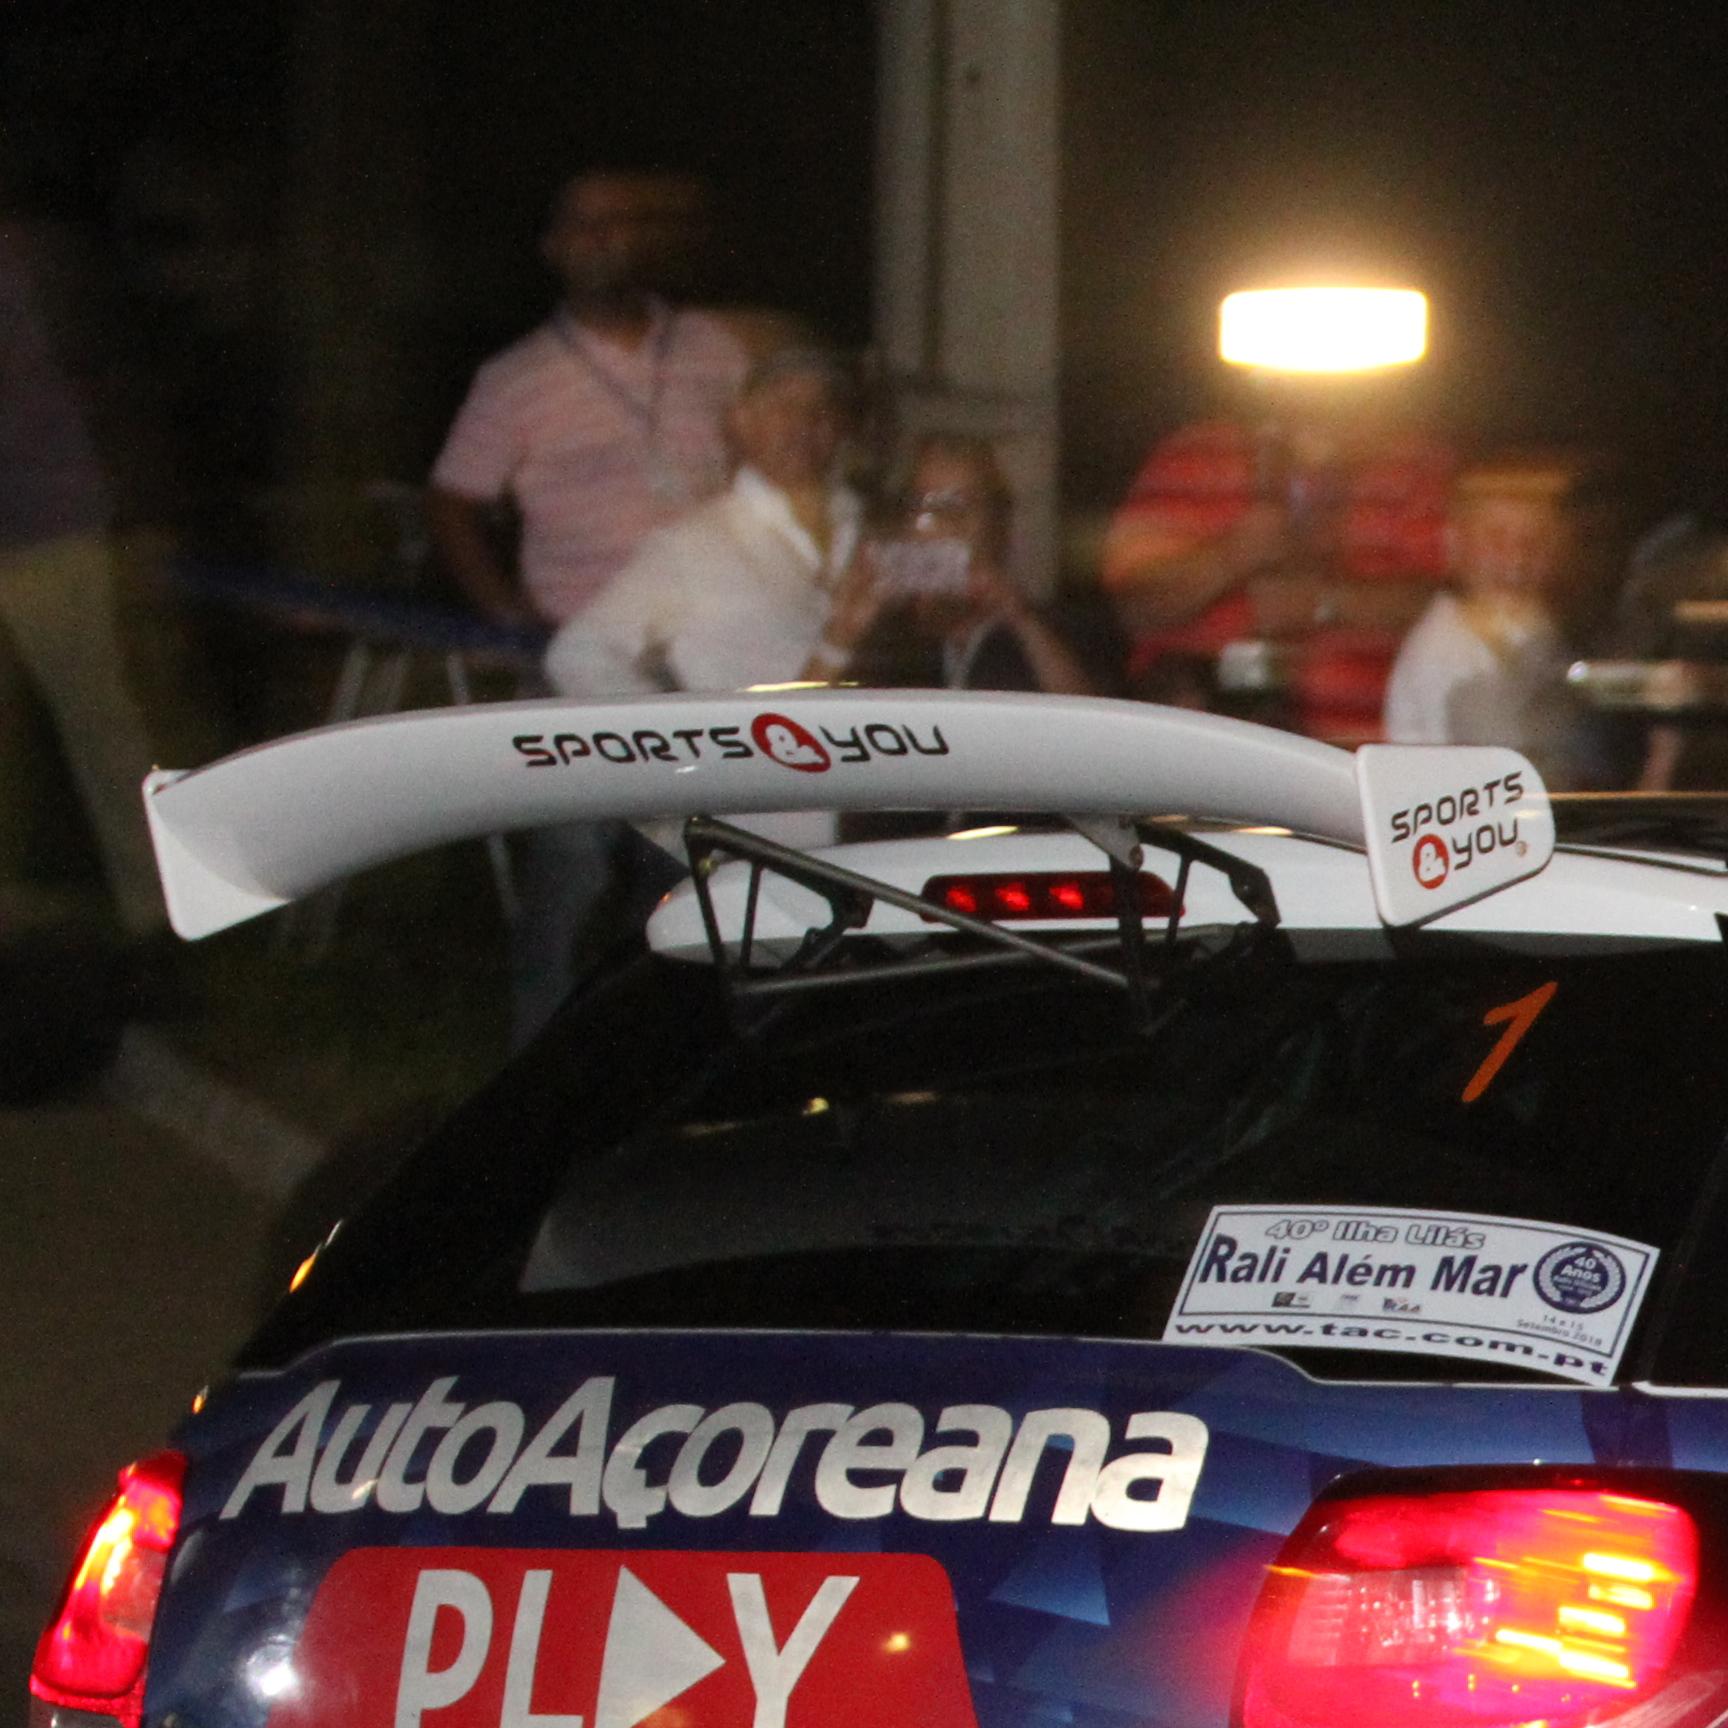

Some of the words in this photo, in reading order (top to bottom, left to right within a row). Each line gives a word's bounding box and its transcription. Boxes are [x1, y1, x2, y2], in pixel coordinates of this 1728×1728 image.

[1391, 770, 1525, 843] SPORTS
[1461, 981, 1558, 1103] 1
[1198, 1232, 1291, 1284] Rali
[1296, 1252, 1416, 1288] Além
[1430, 1254, 1528, 1299] Mar
[1332, 1220, 1398, 1243] Ilha
[1404, 1223, 1487, 1249] Lilás
[1560, 1264, 1601, 1284] Anos
[1176, 1322, 1609, 1377] www.tac.com.pt
[220, 1376, 1209, 1532] AutoAçoreana
